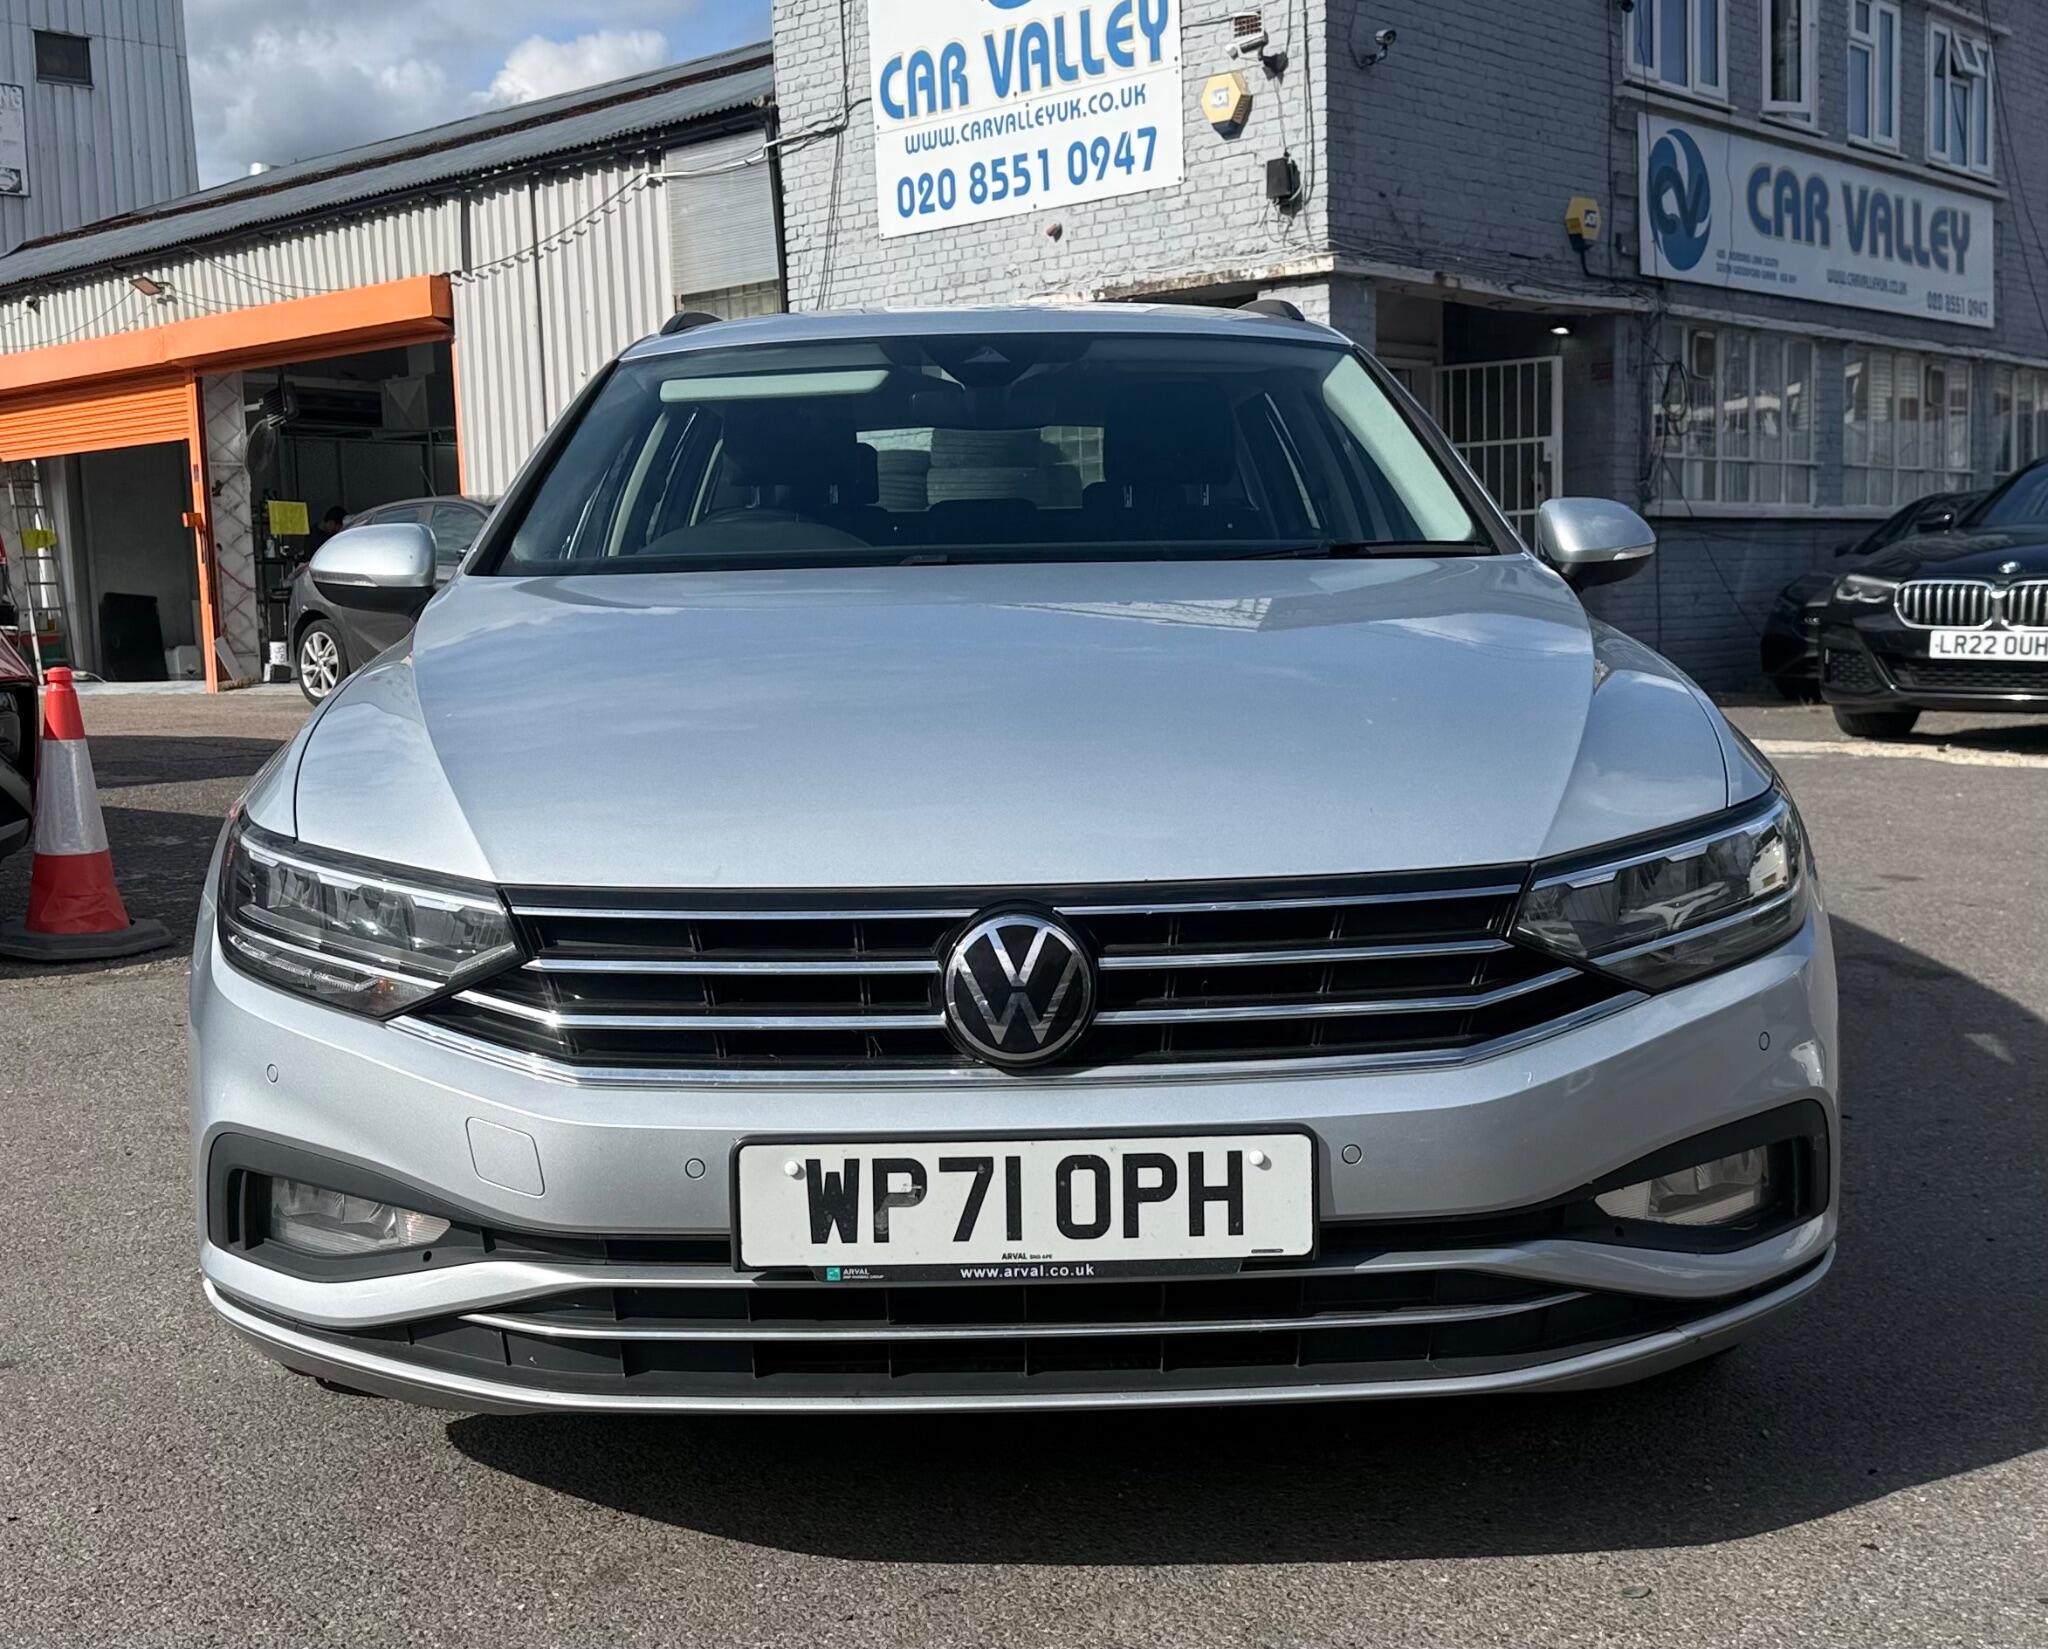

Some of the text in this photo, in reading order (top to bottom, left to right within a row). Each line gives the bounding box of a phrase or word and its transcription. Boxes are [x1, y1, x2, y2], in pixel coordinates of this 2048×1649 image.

[880, 0, 1169, 120] CAR VALLEY
[905, 84, 1147, 155] WWW.CARVALLEYUK.CO.UK
[897, 126, 1158, 218] 020 8551 0947
[1748, 164, 1971, 275] CAR VALLEY
[1967, 299, 1988, 318] 0947
[1940, 634, 2048, 656] LR22 OUH
[805, 1150, 1244, 1245] WP71 OPH
[843, 1267, 870, 1276] ARVAL
[960, 1263, 1095, 1279] www.arval.co.uk
[1002, 1252, 1027, 1260] ARVAL
